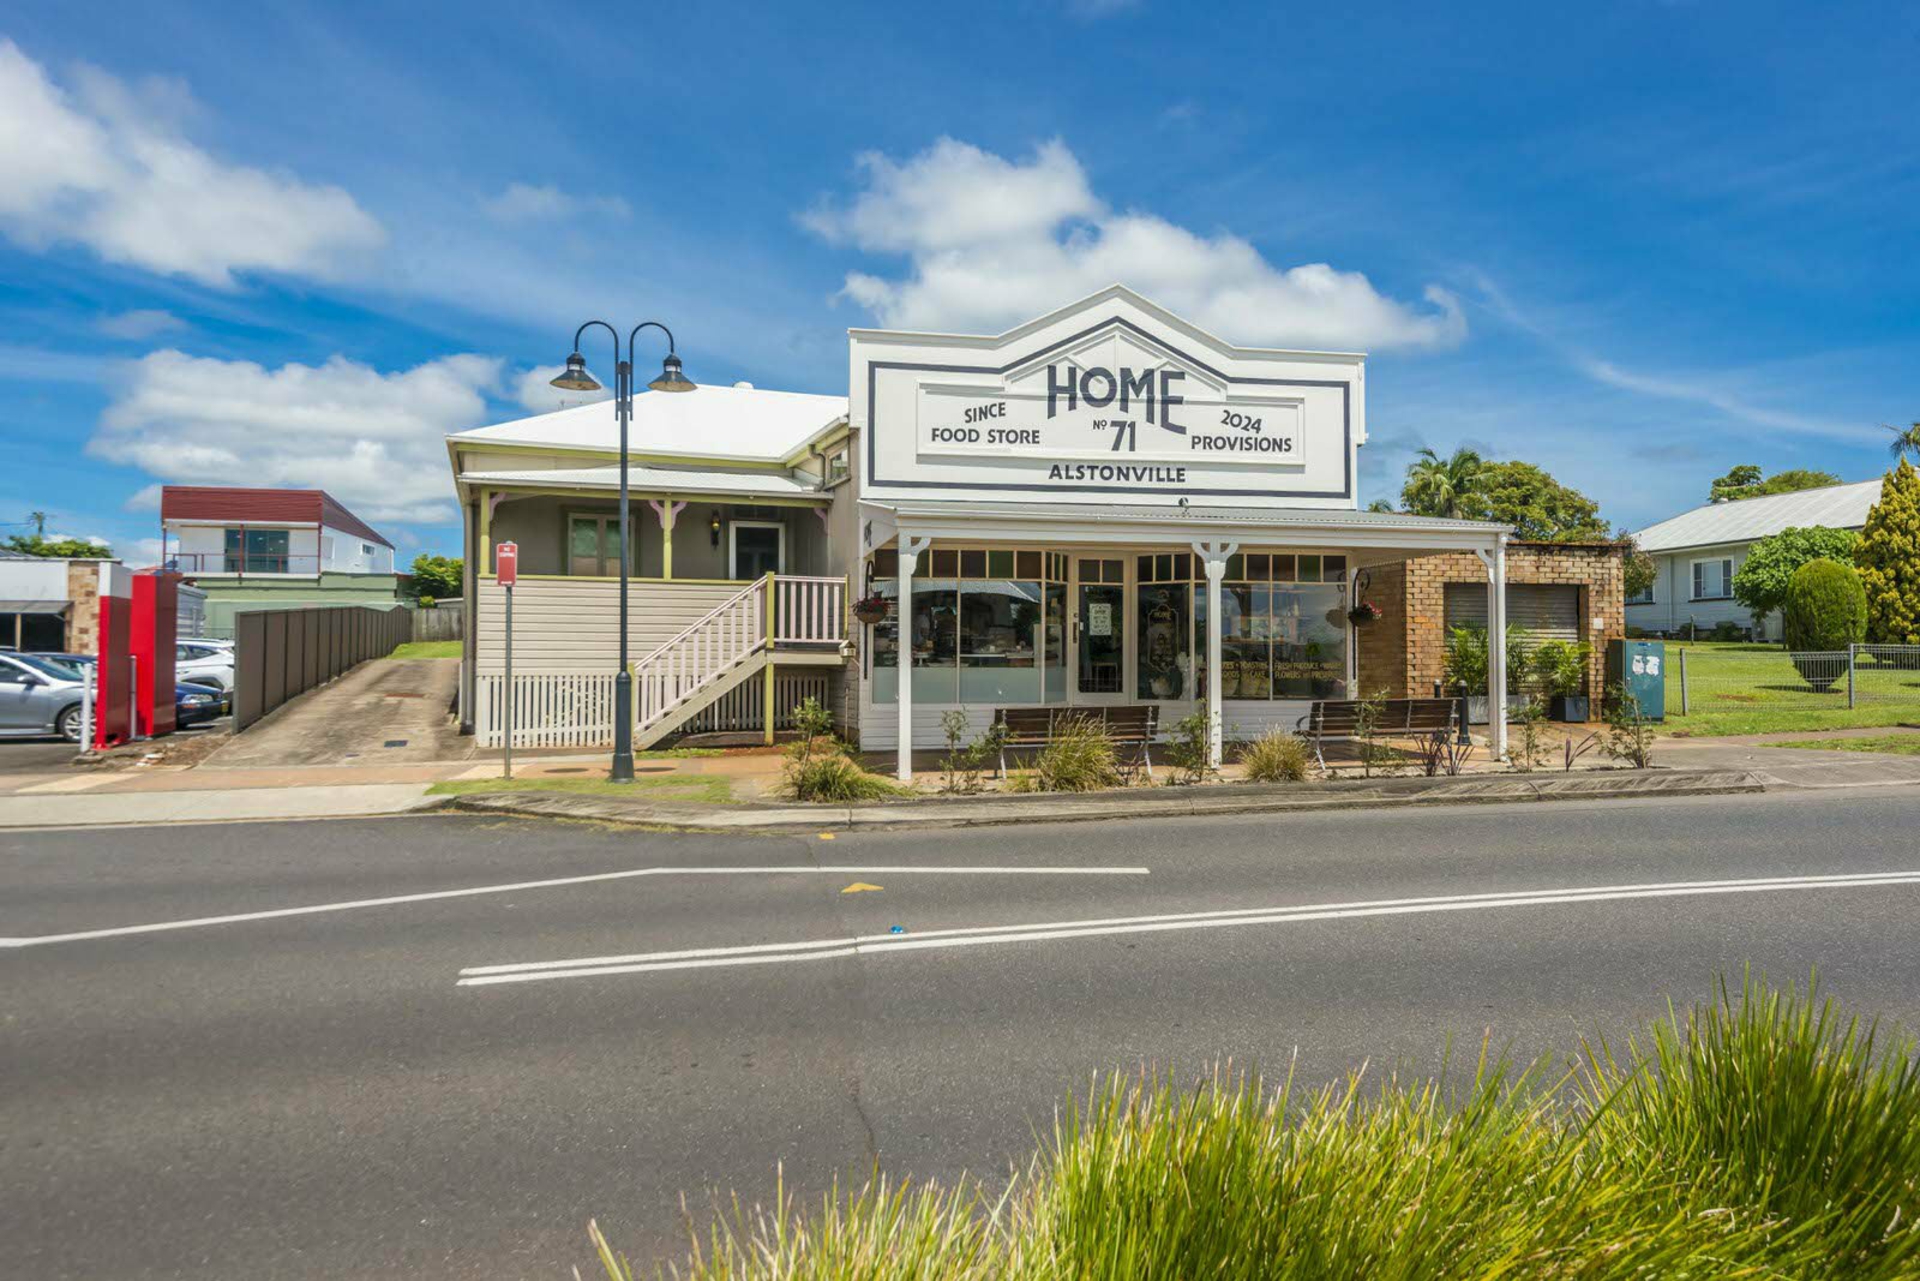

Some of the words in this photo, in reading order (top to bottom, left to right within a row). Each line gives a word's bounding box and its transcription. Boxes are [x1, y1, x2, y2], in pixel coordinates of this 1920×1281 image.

[1047, 365, 1187, 435] HOME
[964, 402, 1006, 423] SINCE
[1220, 409, 1262, 434] 2024
[931, 427, 980, 442] FOOD
[987, 429, 1040, 444] STORE
[1110, 420, 1136, 452] 71
[1191, 435, 1292, 452] PROVISIONS
[1049, 464, 1186, 482] ALSTONVILLE
